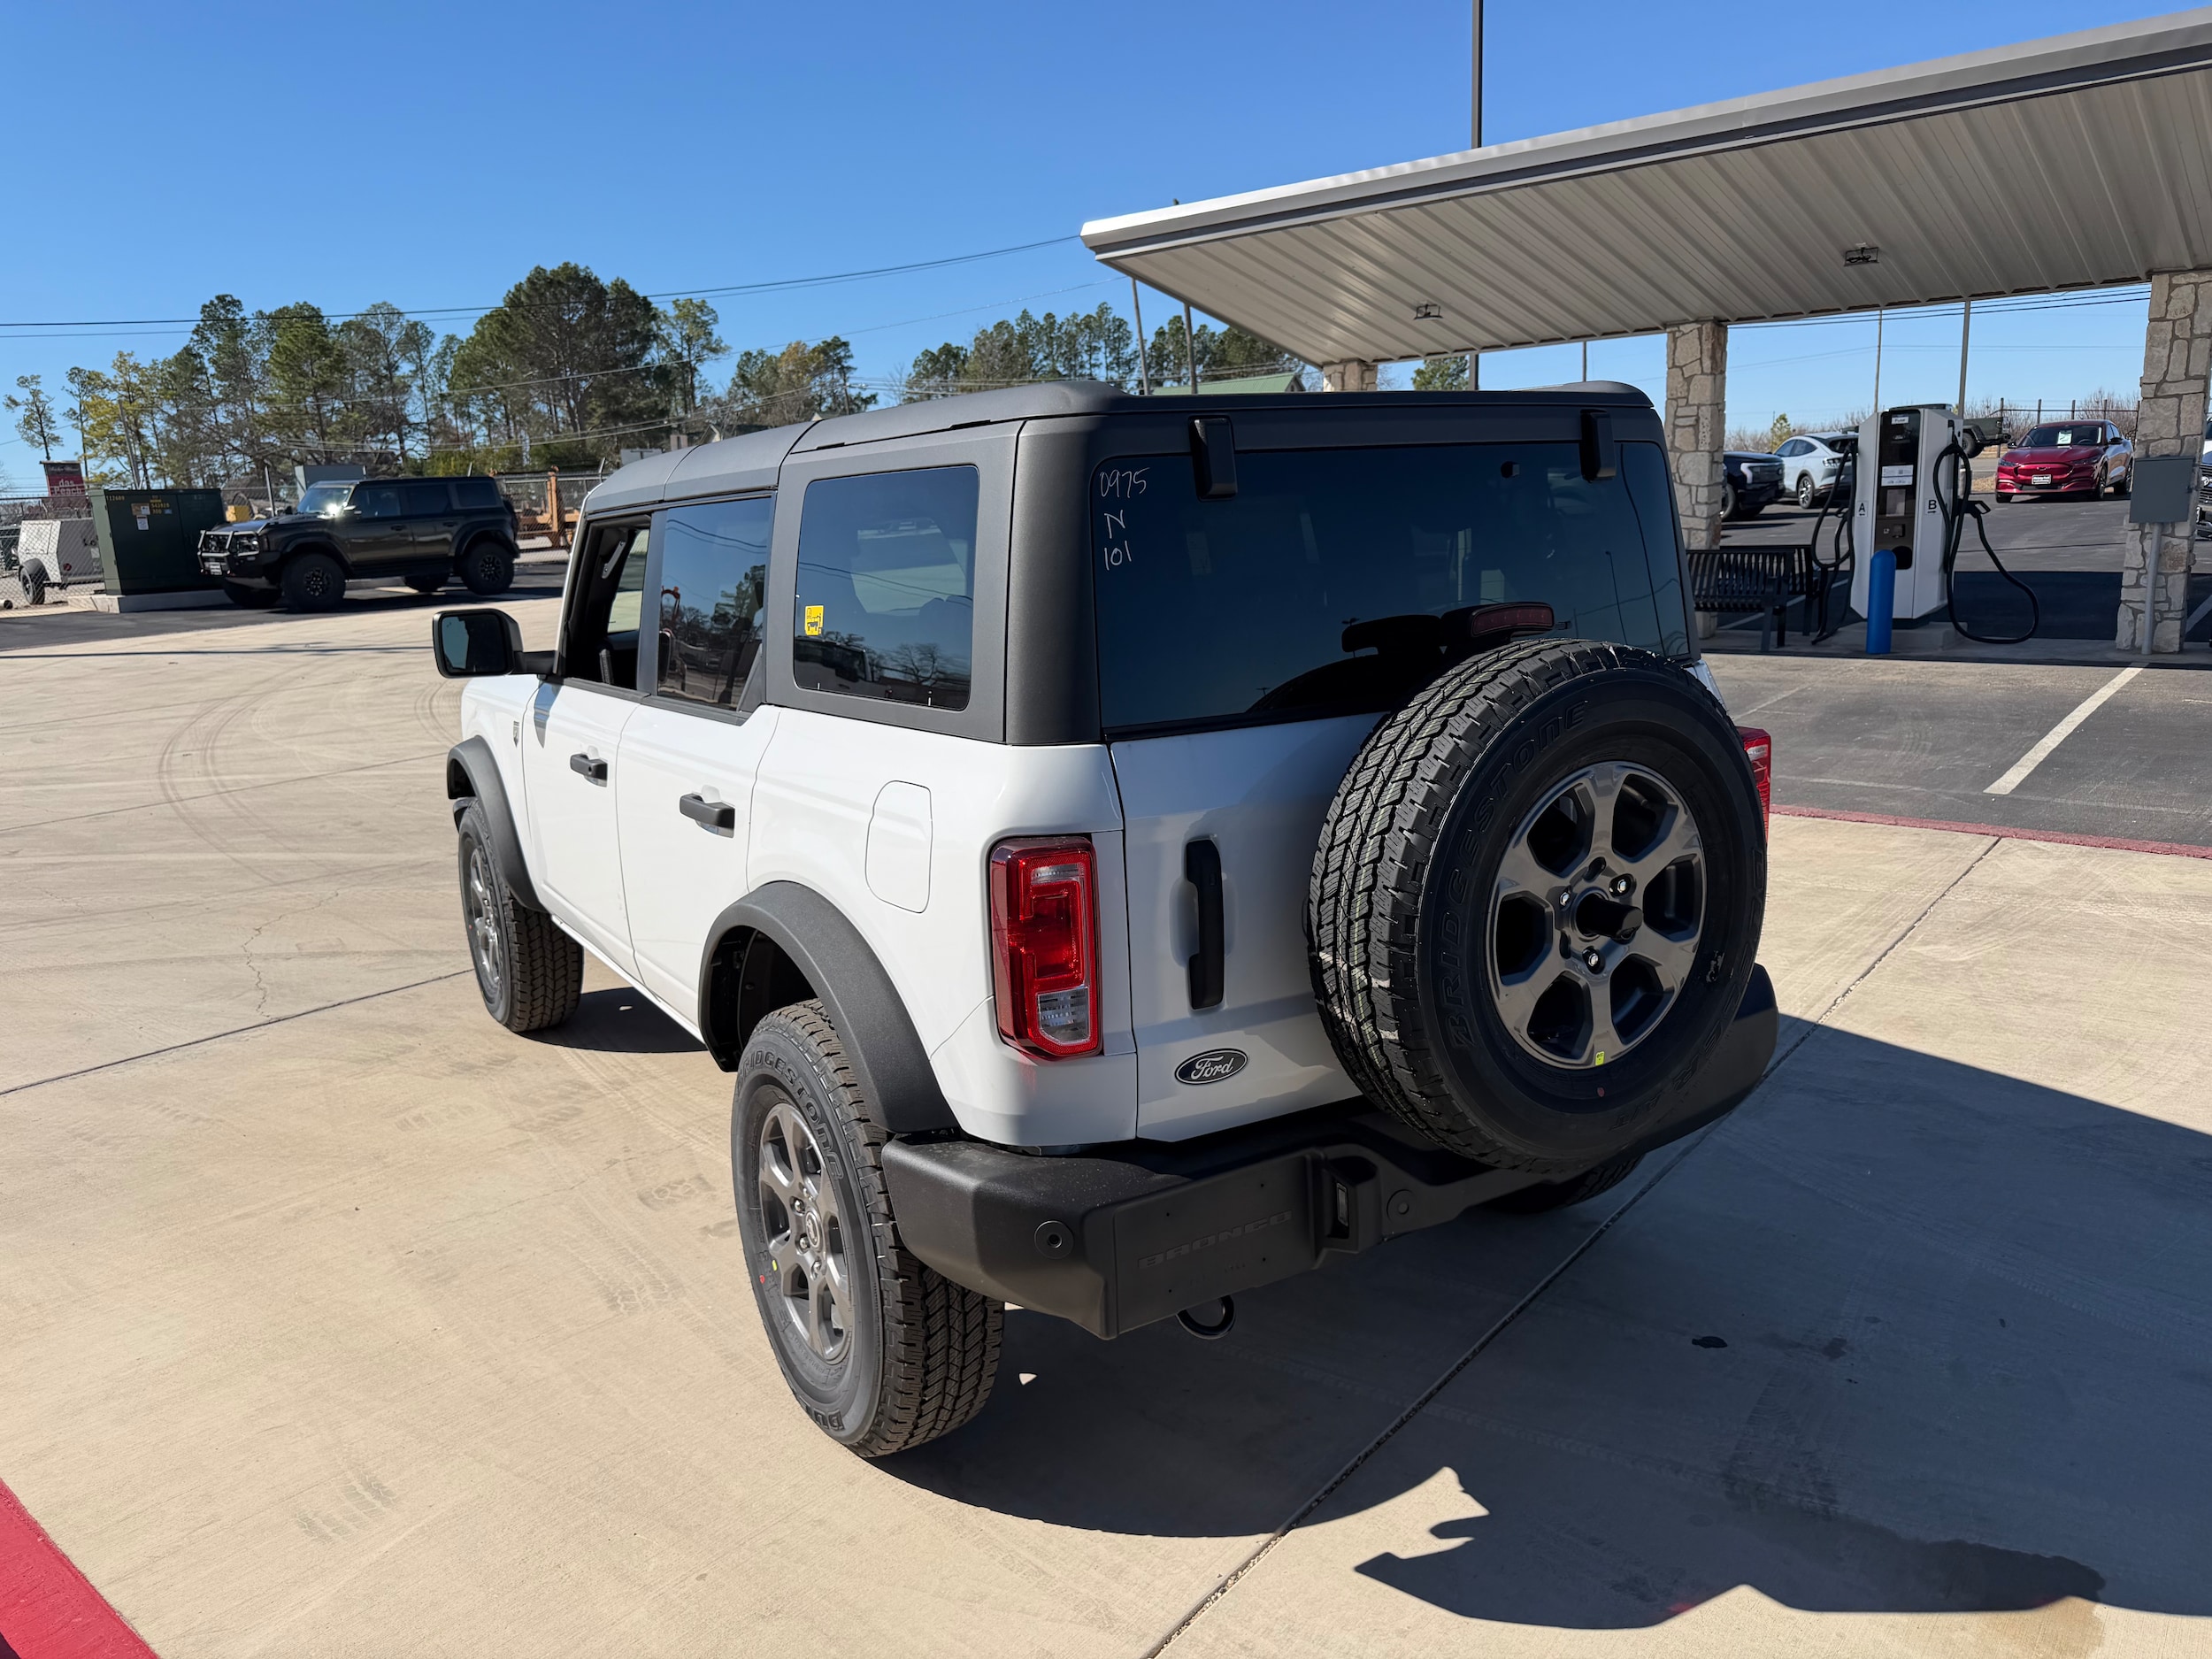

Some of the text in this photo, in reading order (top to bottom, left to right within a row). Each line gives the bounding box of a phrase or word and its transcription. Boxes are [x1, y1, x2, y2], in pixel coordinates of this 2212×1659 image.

[1099, 467, 1150, 498] 0975
[1858, 503, 1866, 512] A
[1928, 500, 1937, 510] B
[1104, 541, 1132, 571] 101
[1438, 700, 1589, 1049] BRIDGESTONE
[1190, 1055, 1235, 1080] Ford
[735, 1049, 845, 1180] BRIDGESTONE
[1138, 1209, 1294, 1269] BRONCO
